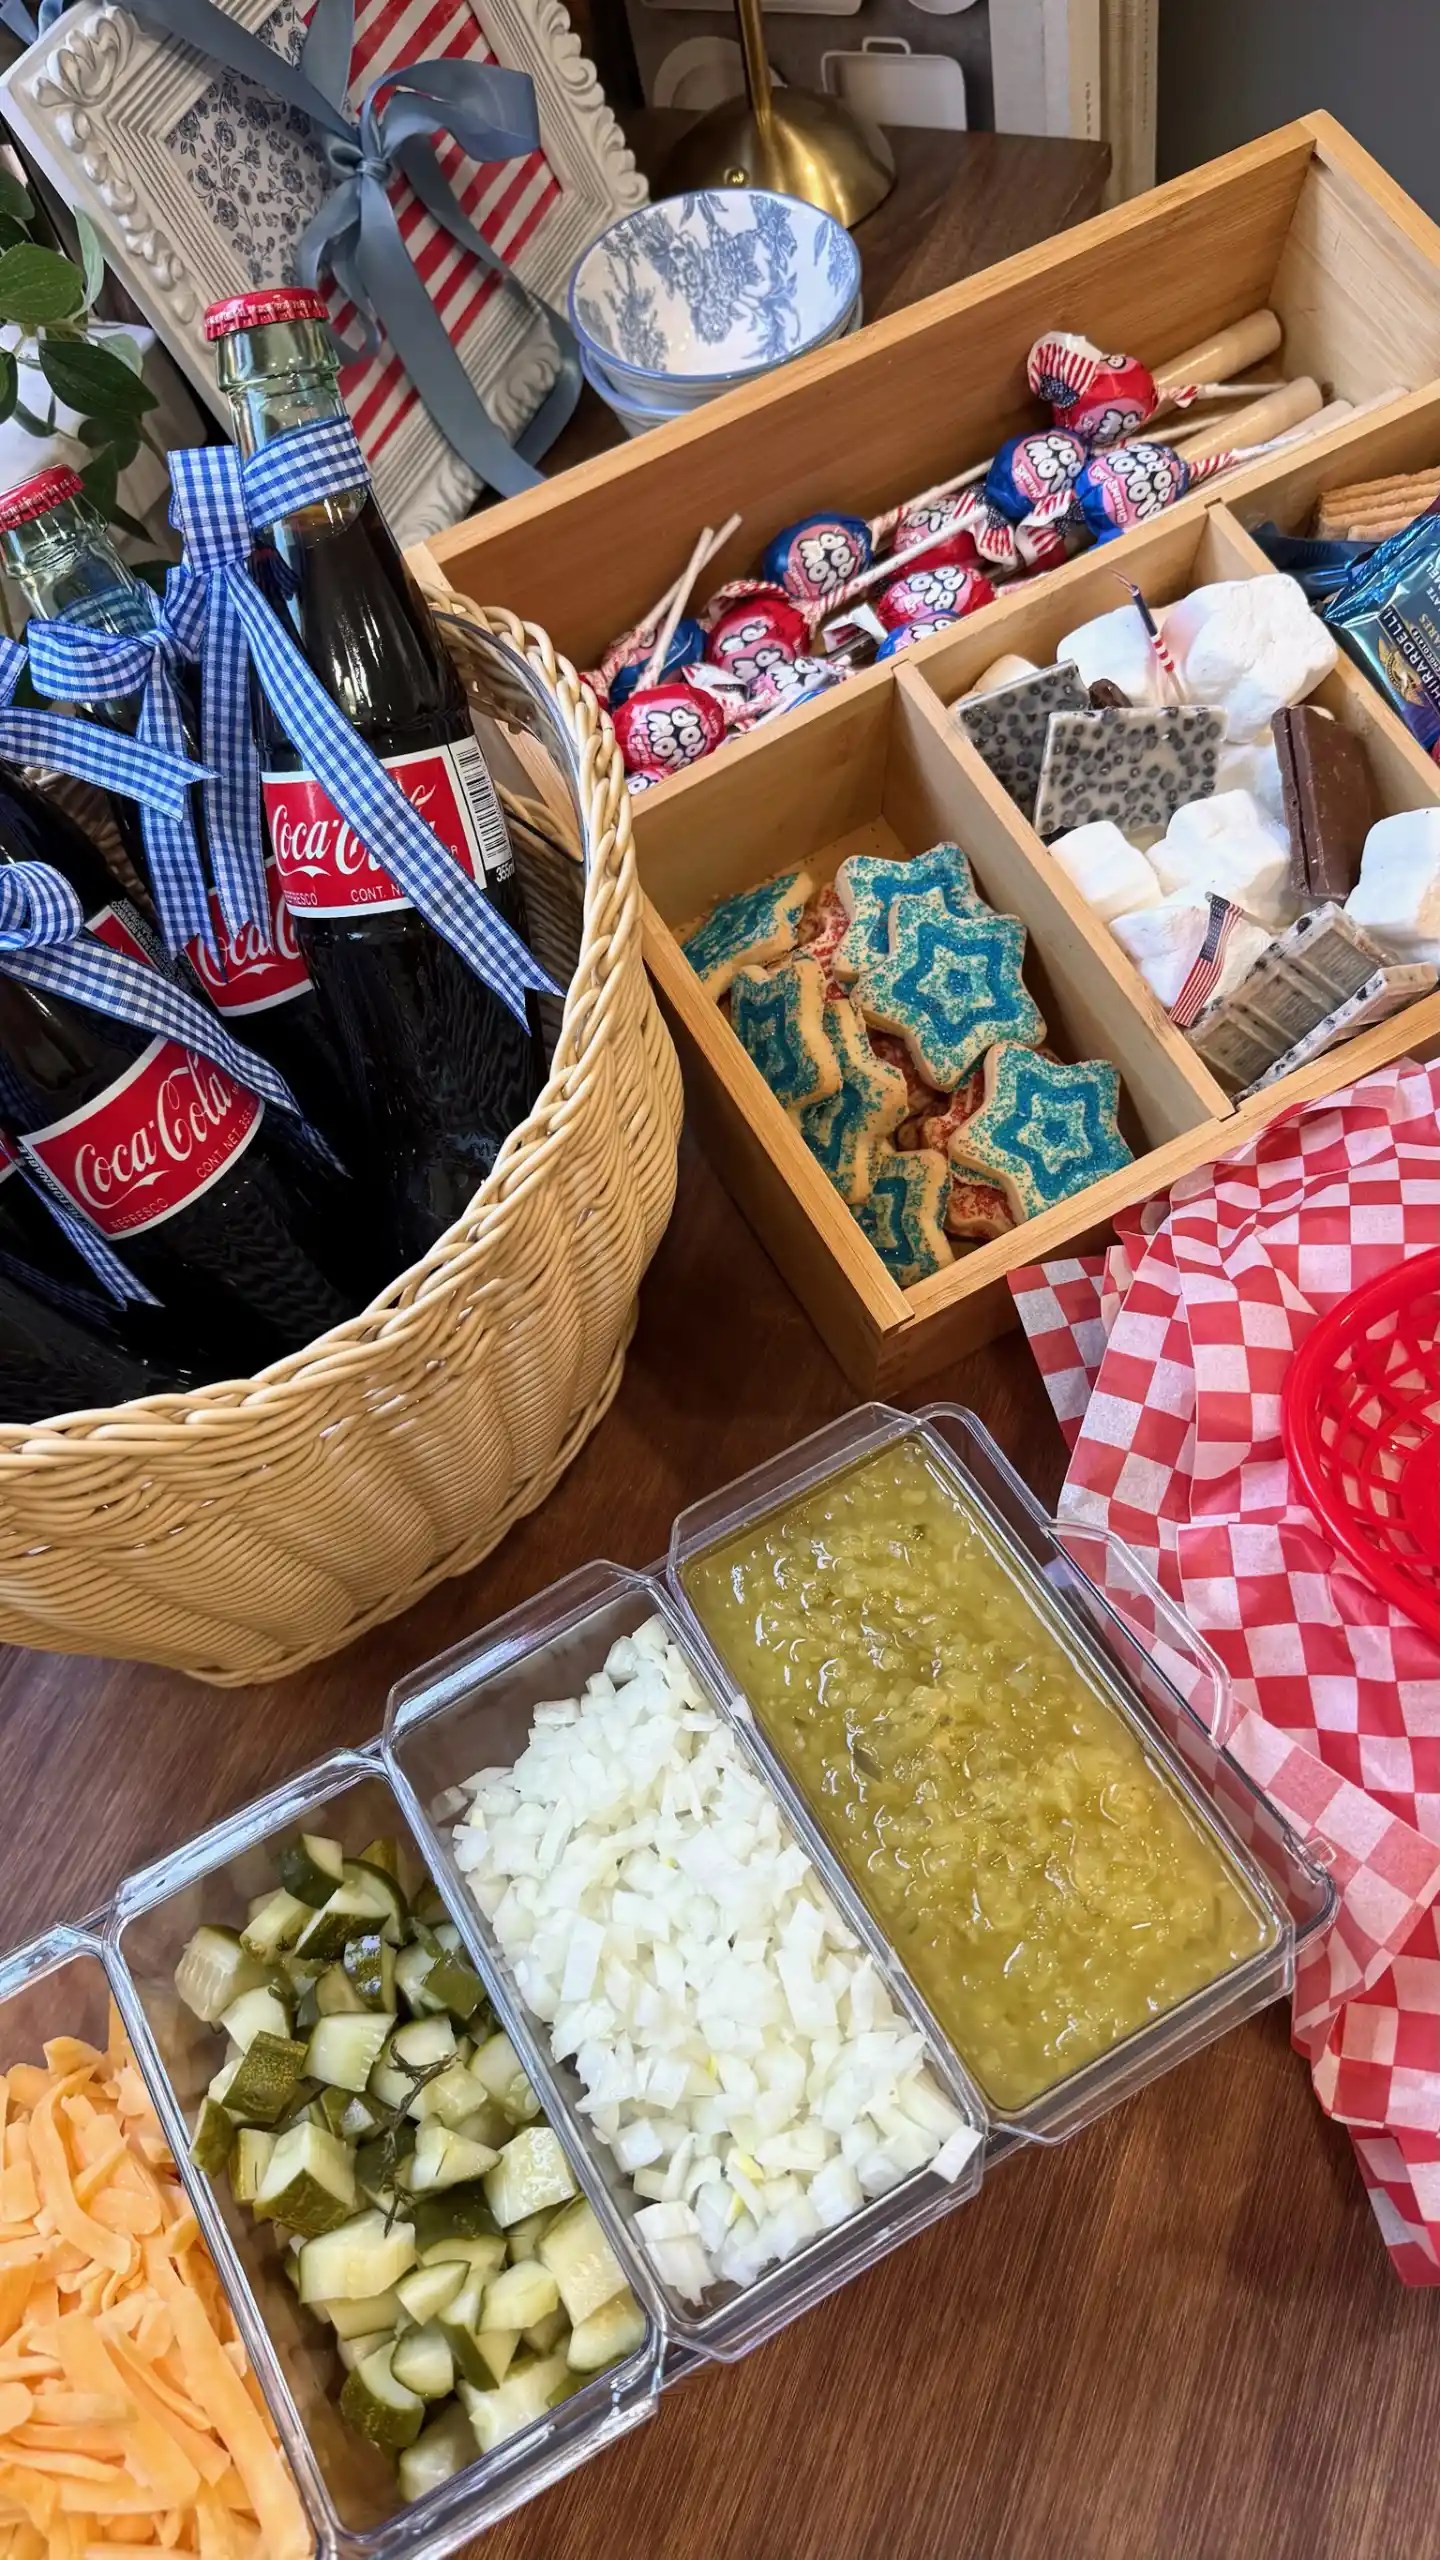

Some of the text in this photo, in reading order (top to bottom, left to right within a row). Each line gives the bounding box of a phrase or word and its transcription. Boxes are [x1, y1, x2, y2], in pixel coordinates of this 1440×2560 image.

[1014, 466, 1043, 498] HARMS
[799, 540, 843, 594] LOW
[819, 532, 856, 579] POP
[906, 573, 957, 612] BLO
[1383, 610, 1440, 706] HIRARDELLI
[671, 706, 707, 758] POP
[351, 886, 386, 902] CONT.
[75, 1049, 233, 1210] Coca-Cola
[109, 1197, 169, 1230] REFRESCO
